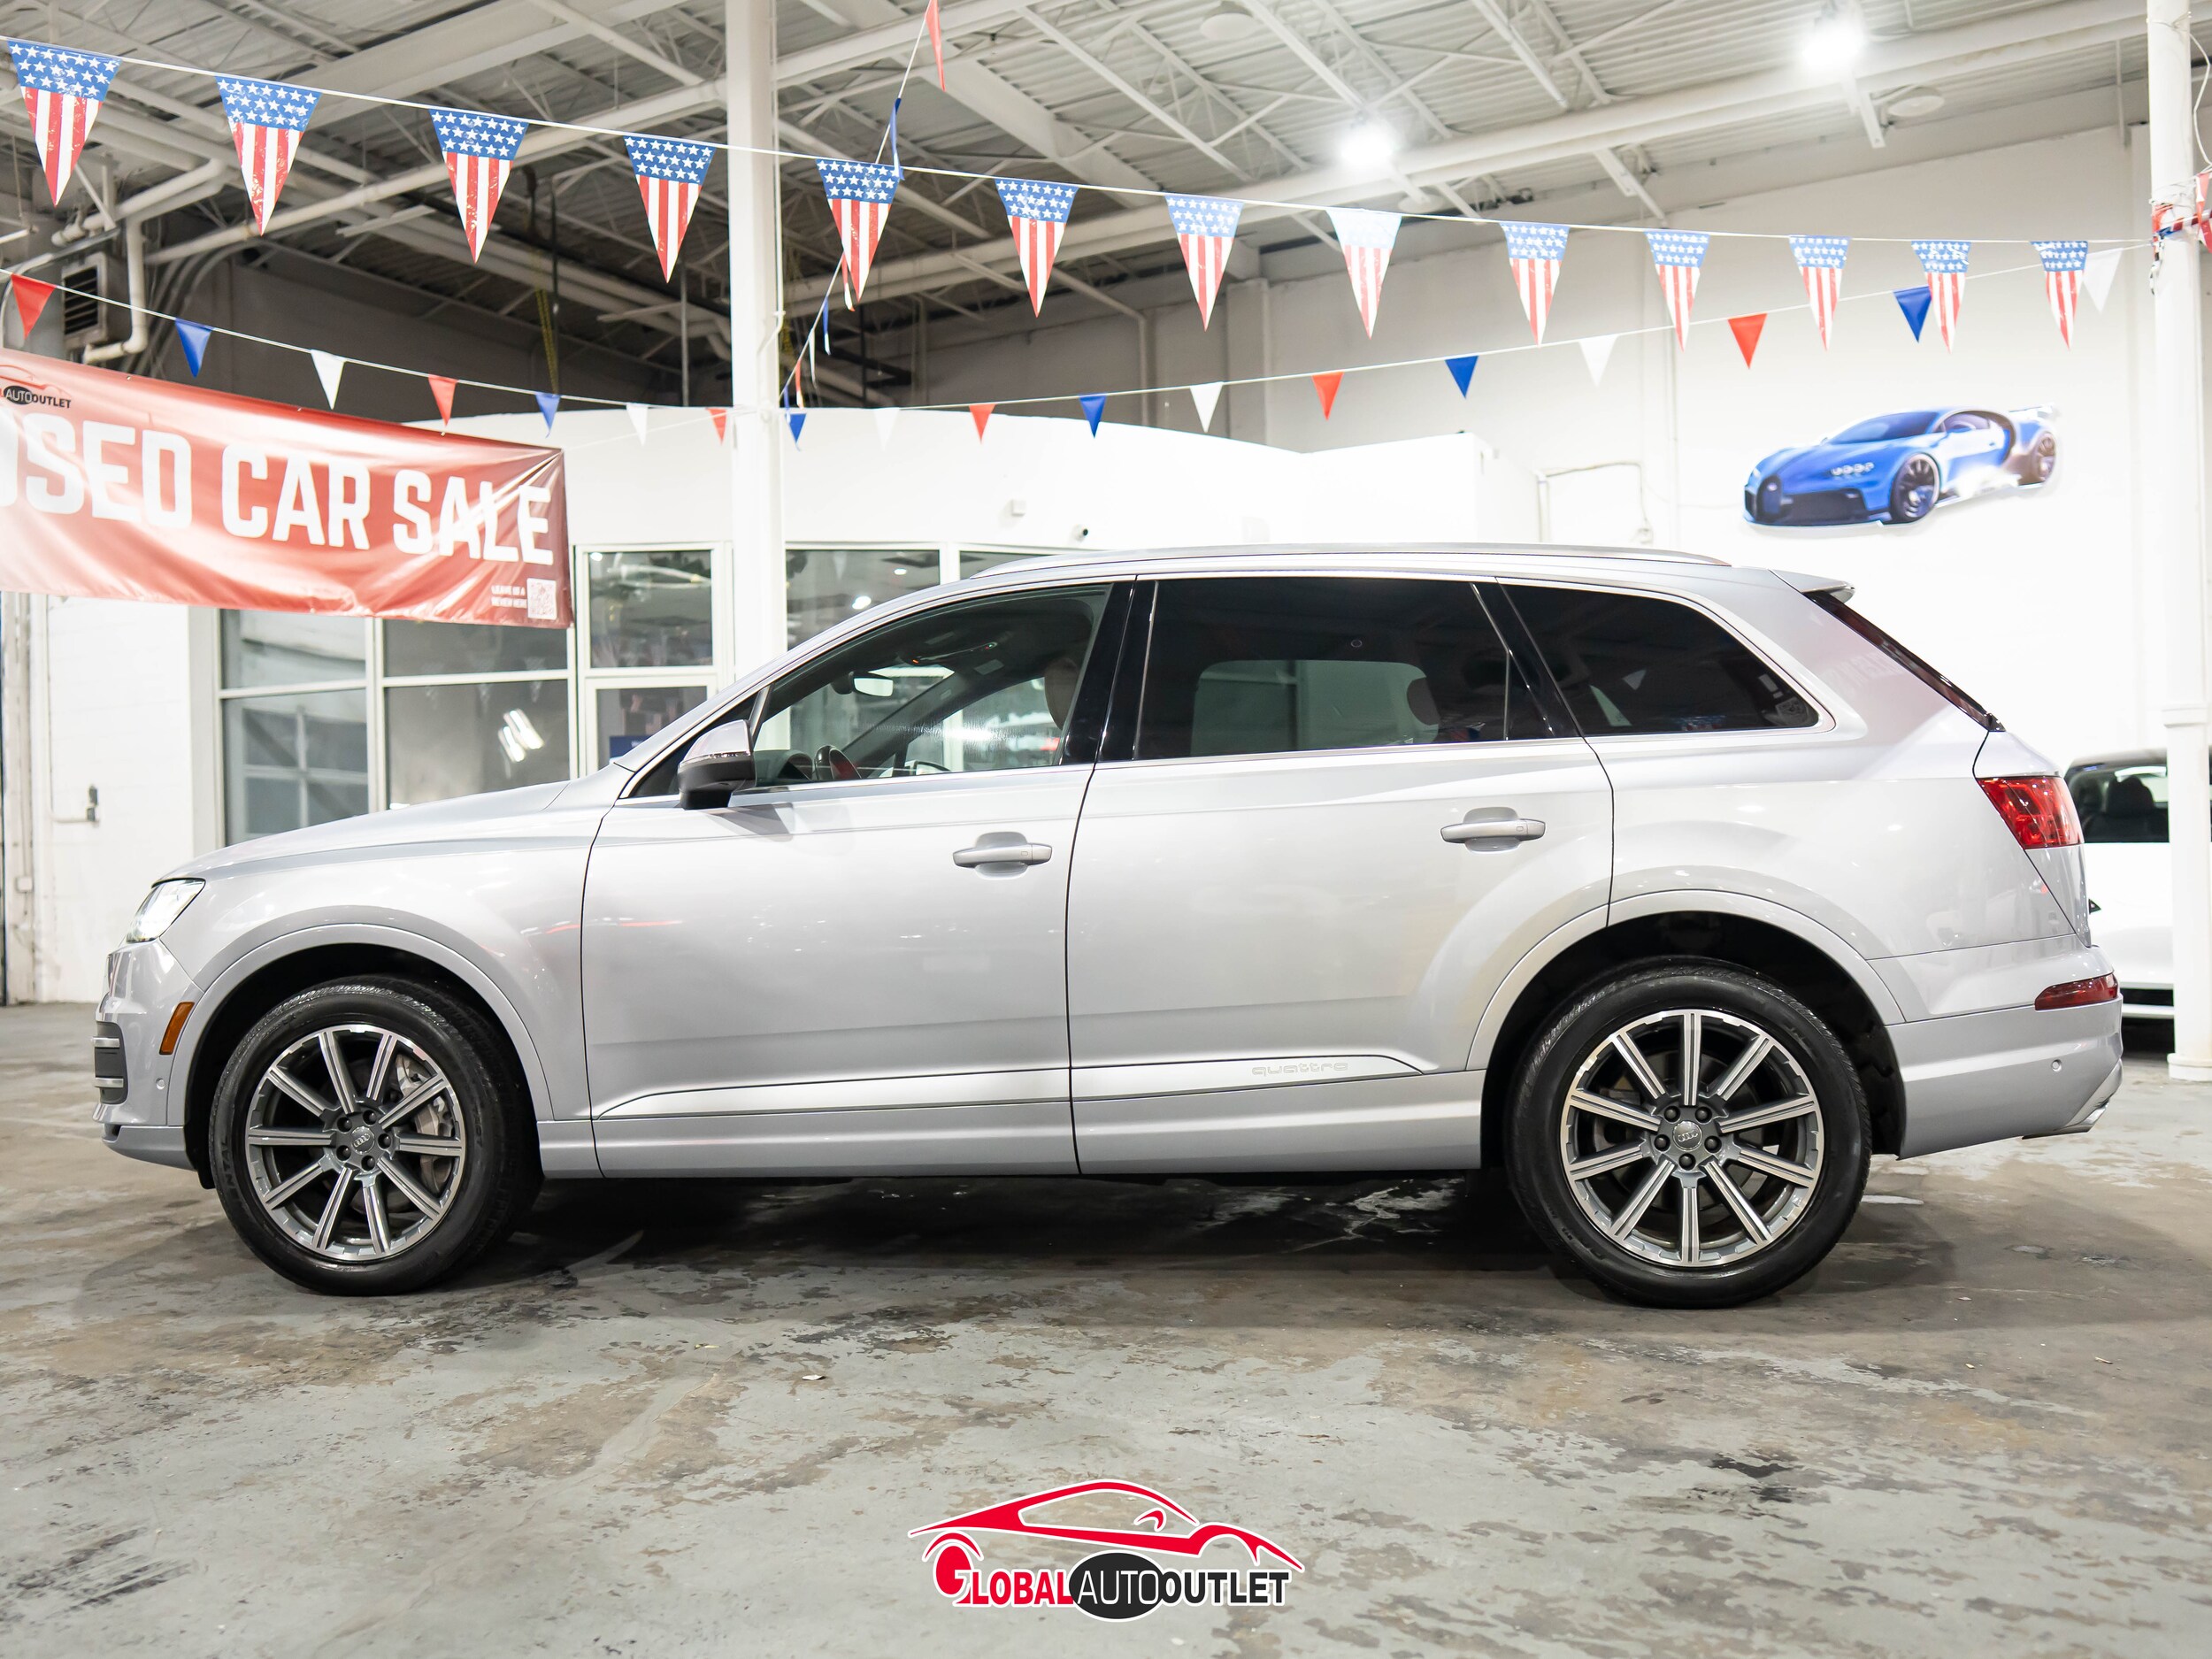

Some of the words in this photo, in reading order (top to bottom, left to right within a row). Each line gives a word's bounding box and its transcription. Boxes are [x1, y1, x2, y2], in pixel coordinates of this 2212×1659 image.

[222, 443, 370, 550] CAR
[393, 469, 553, 565] SALE
[1252, 1063, 1348, 1077] quattro
